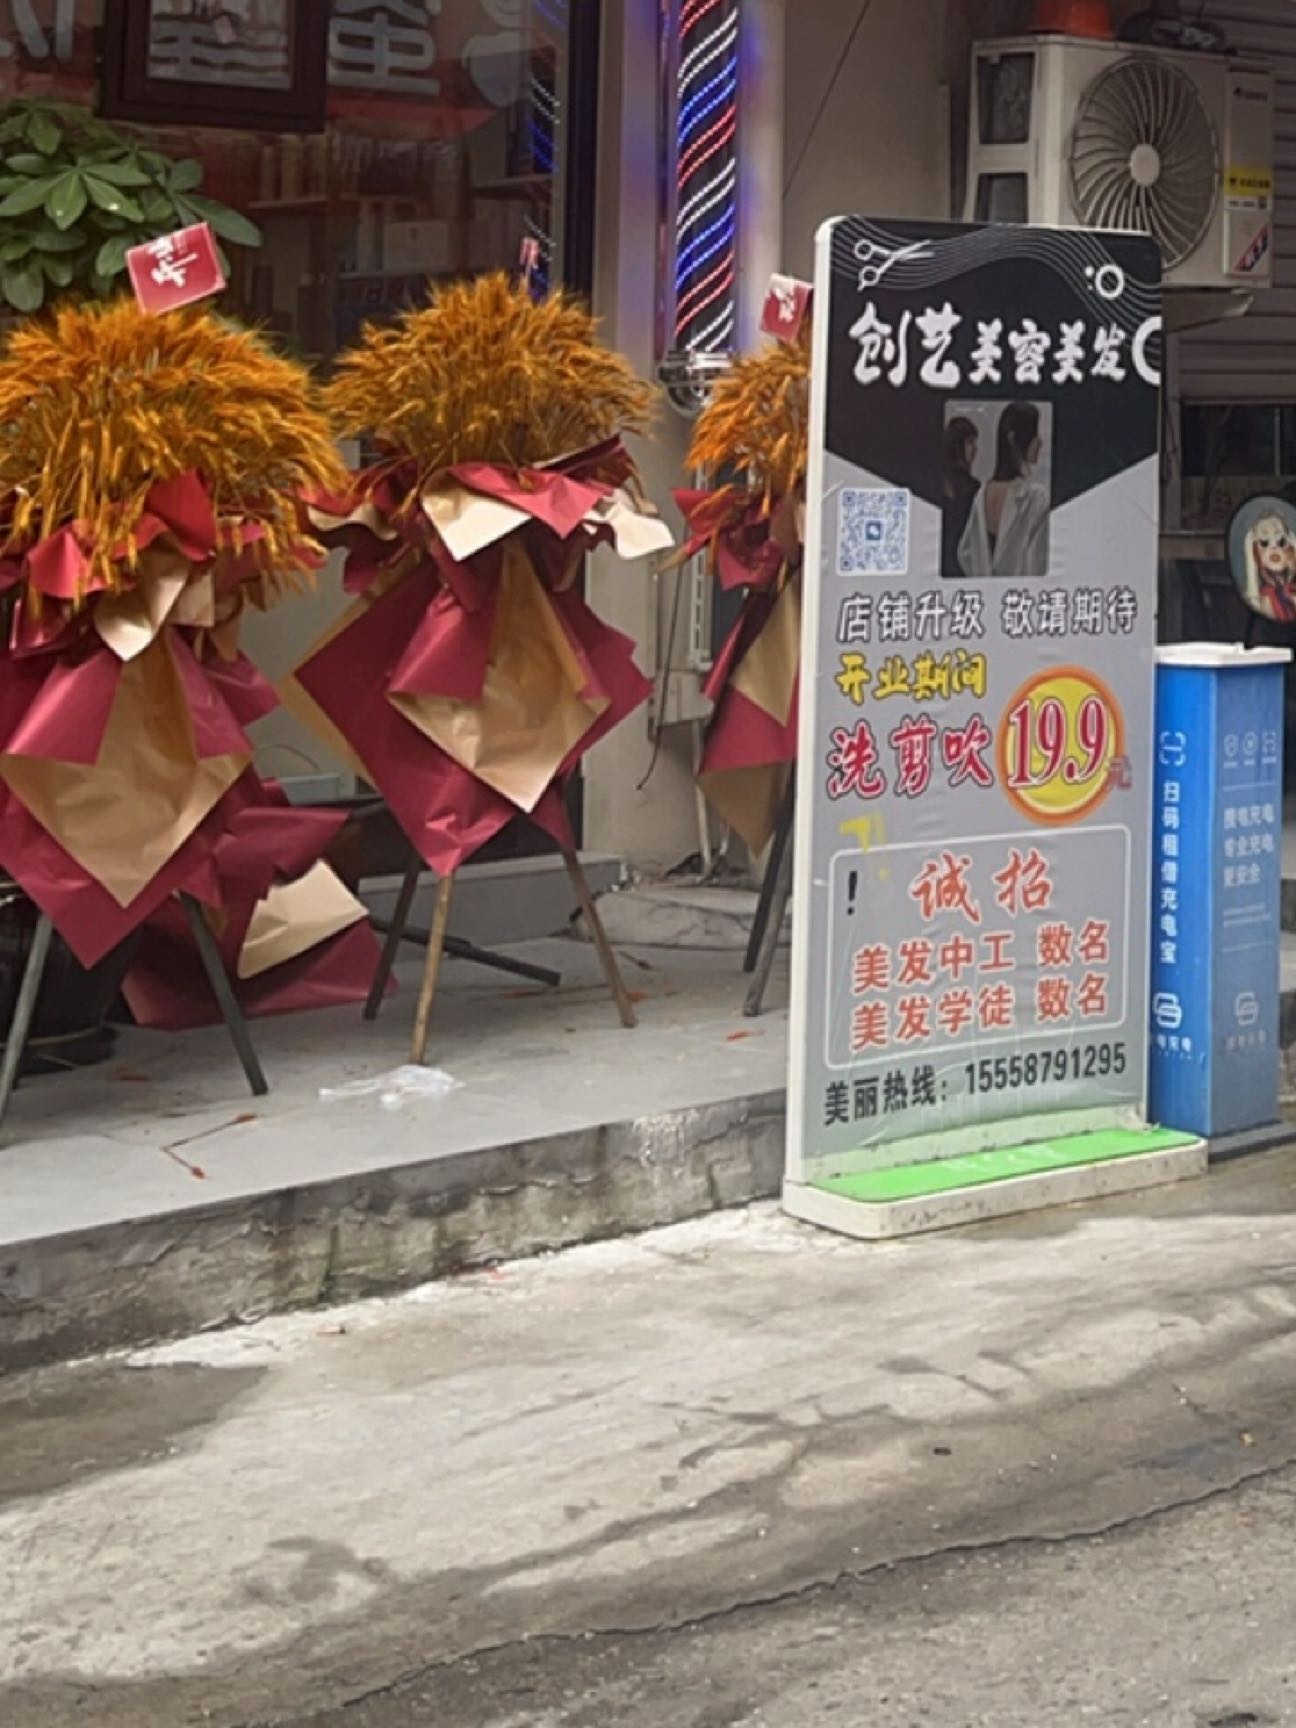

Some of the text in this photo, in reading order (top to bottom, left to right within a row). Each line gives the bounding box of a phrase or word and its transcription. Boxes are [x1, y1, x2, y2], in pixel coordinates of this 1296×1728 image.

[848, 300, 1128, 388] 创艺美容美发
[836, 586, 1138, 642] 店铺升级 敬请期待
[834, 648, 990, 704] 开业期间
[826, 712, 994, 800] 洗剪吹
[912, 848, 1054, 924] 诚招
[854, 920, 1110, 992] 美发中工 数名
[850, 974, 1108, 1052] 美发学徒 数名
[964, 1040, 1127, 1096] 15558791295
